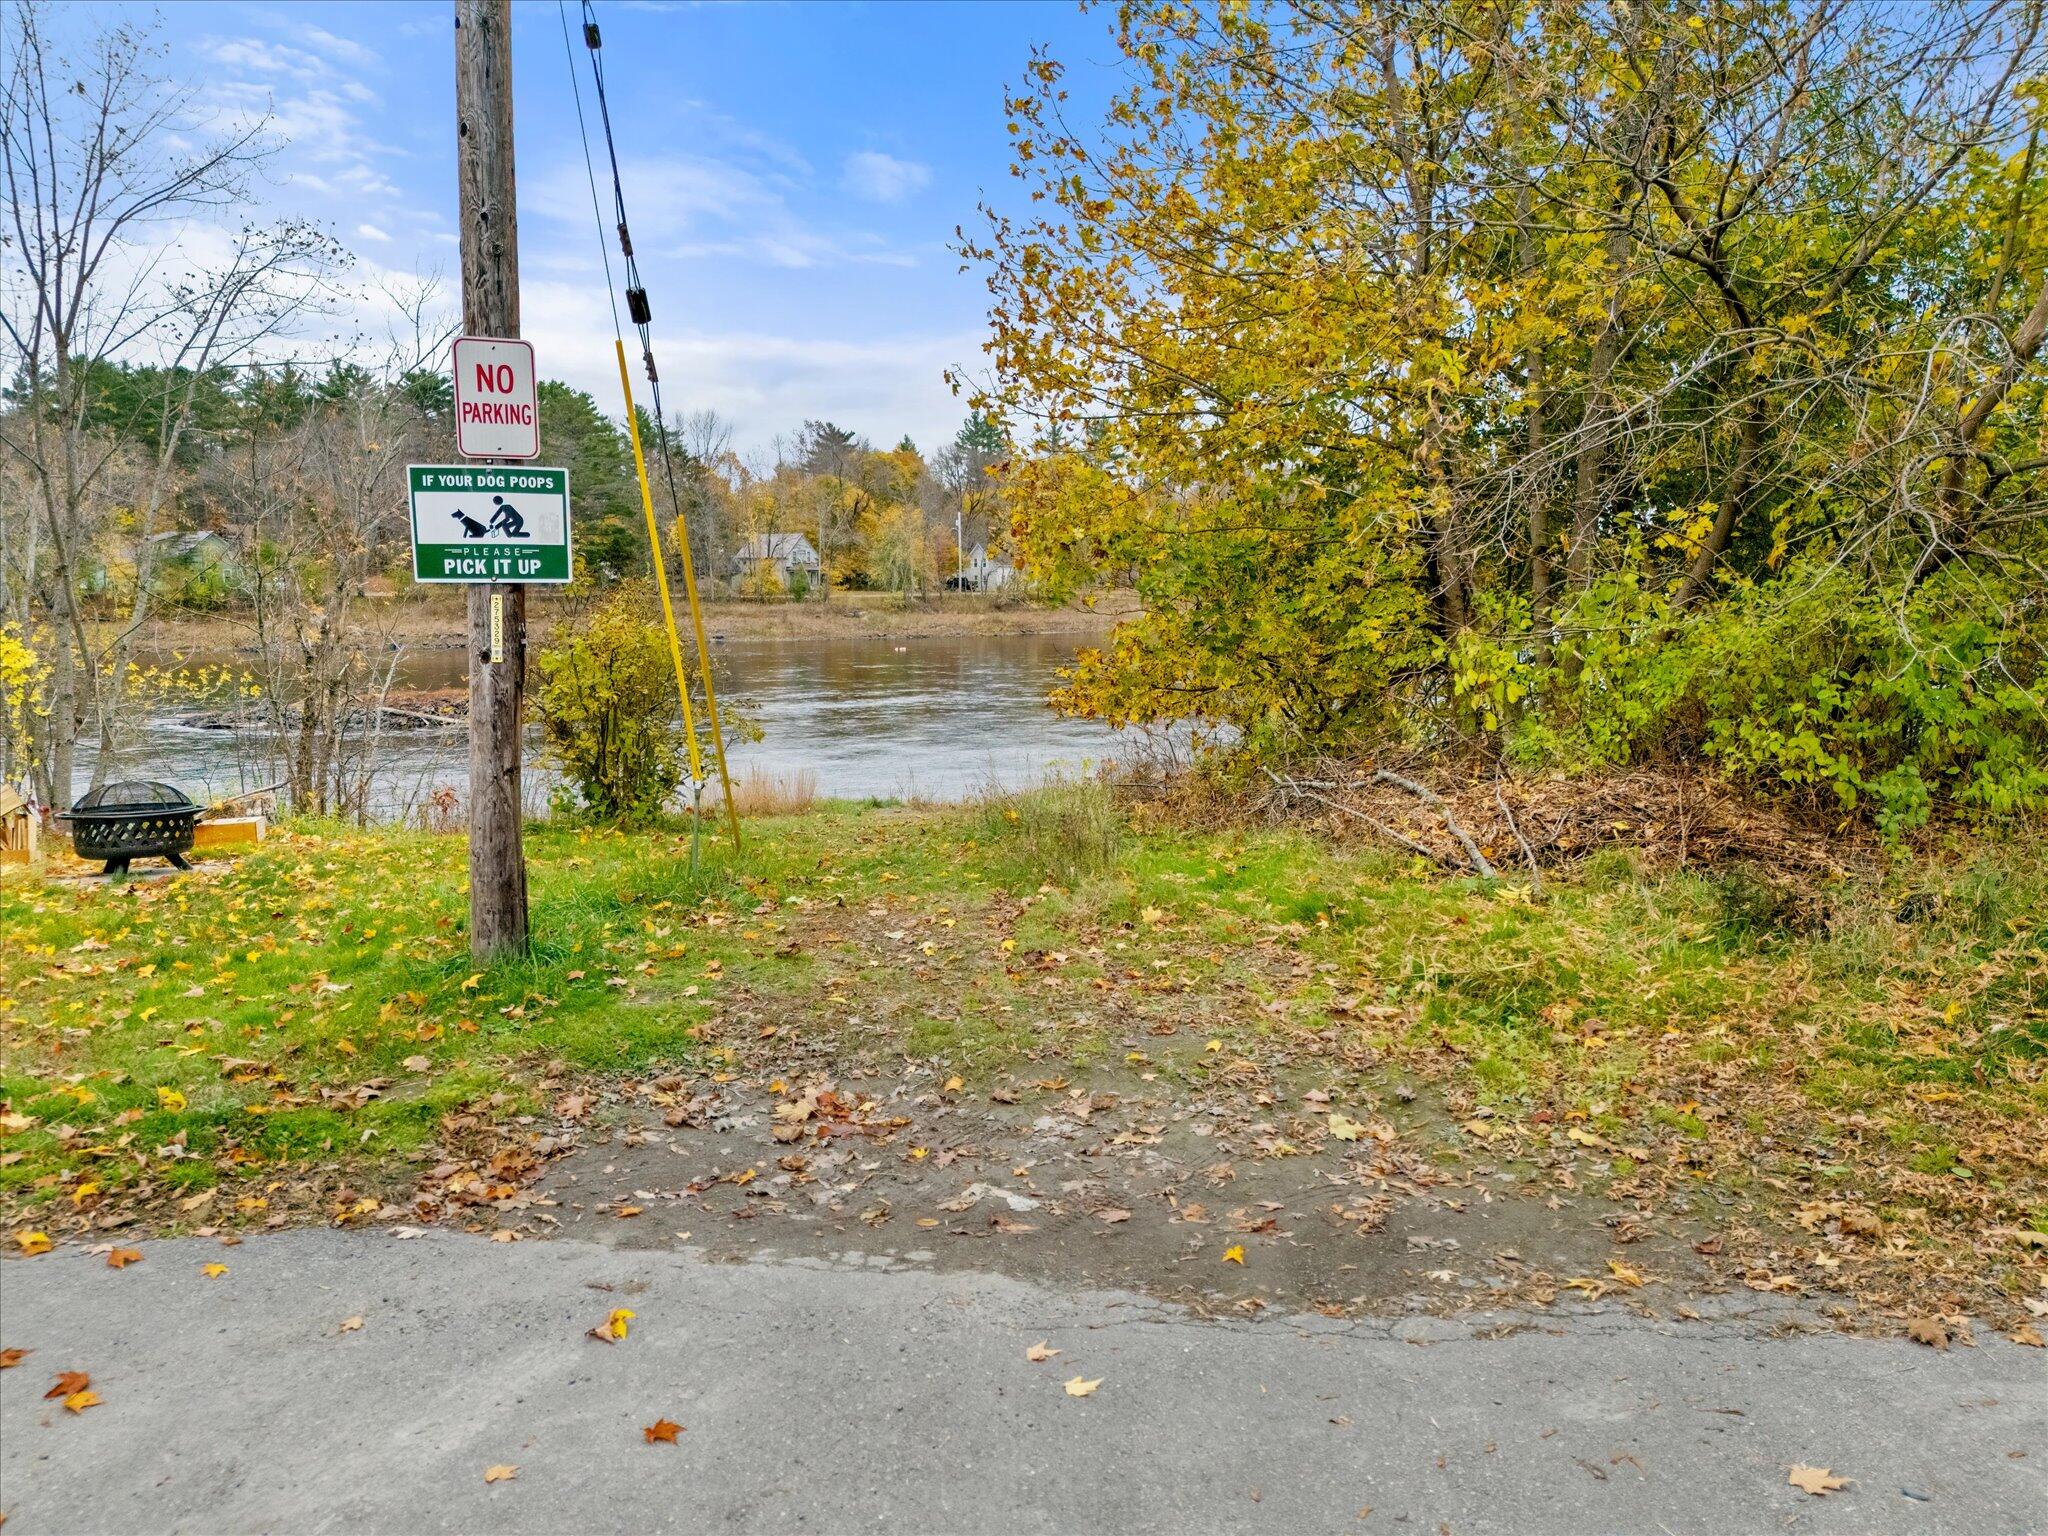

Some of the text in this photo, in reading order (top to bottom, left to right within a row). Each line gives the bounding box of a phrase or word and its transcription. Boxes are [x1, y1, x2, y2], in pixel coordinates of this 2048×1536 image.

[476, 363, 514, 394] NO
[462, 402, 532, 426] PARKING
[422, 474, 554, 489] IF YOUR DOG POOPS
[463, 547, 521, 556] PLEASE
[443, 558, 542, 575] PICK IT UP
